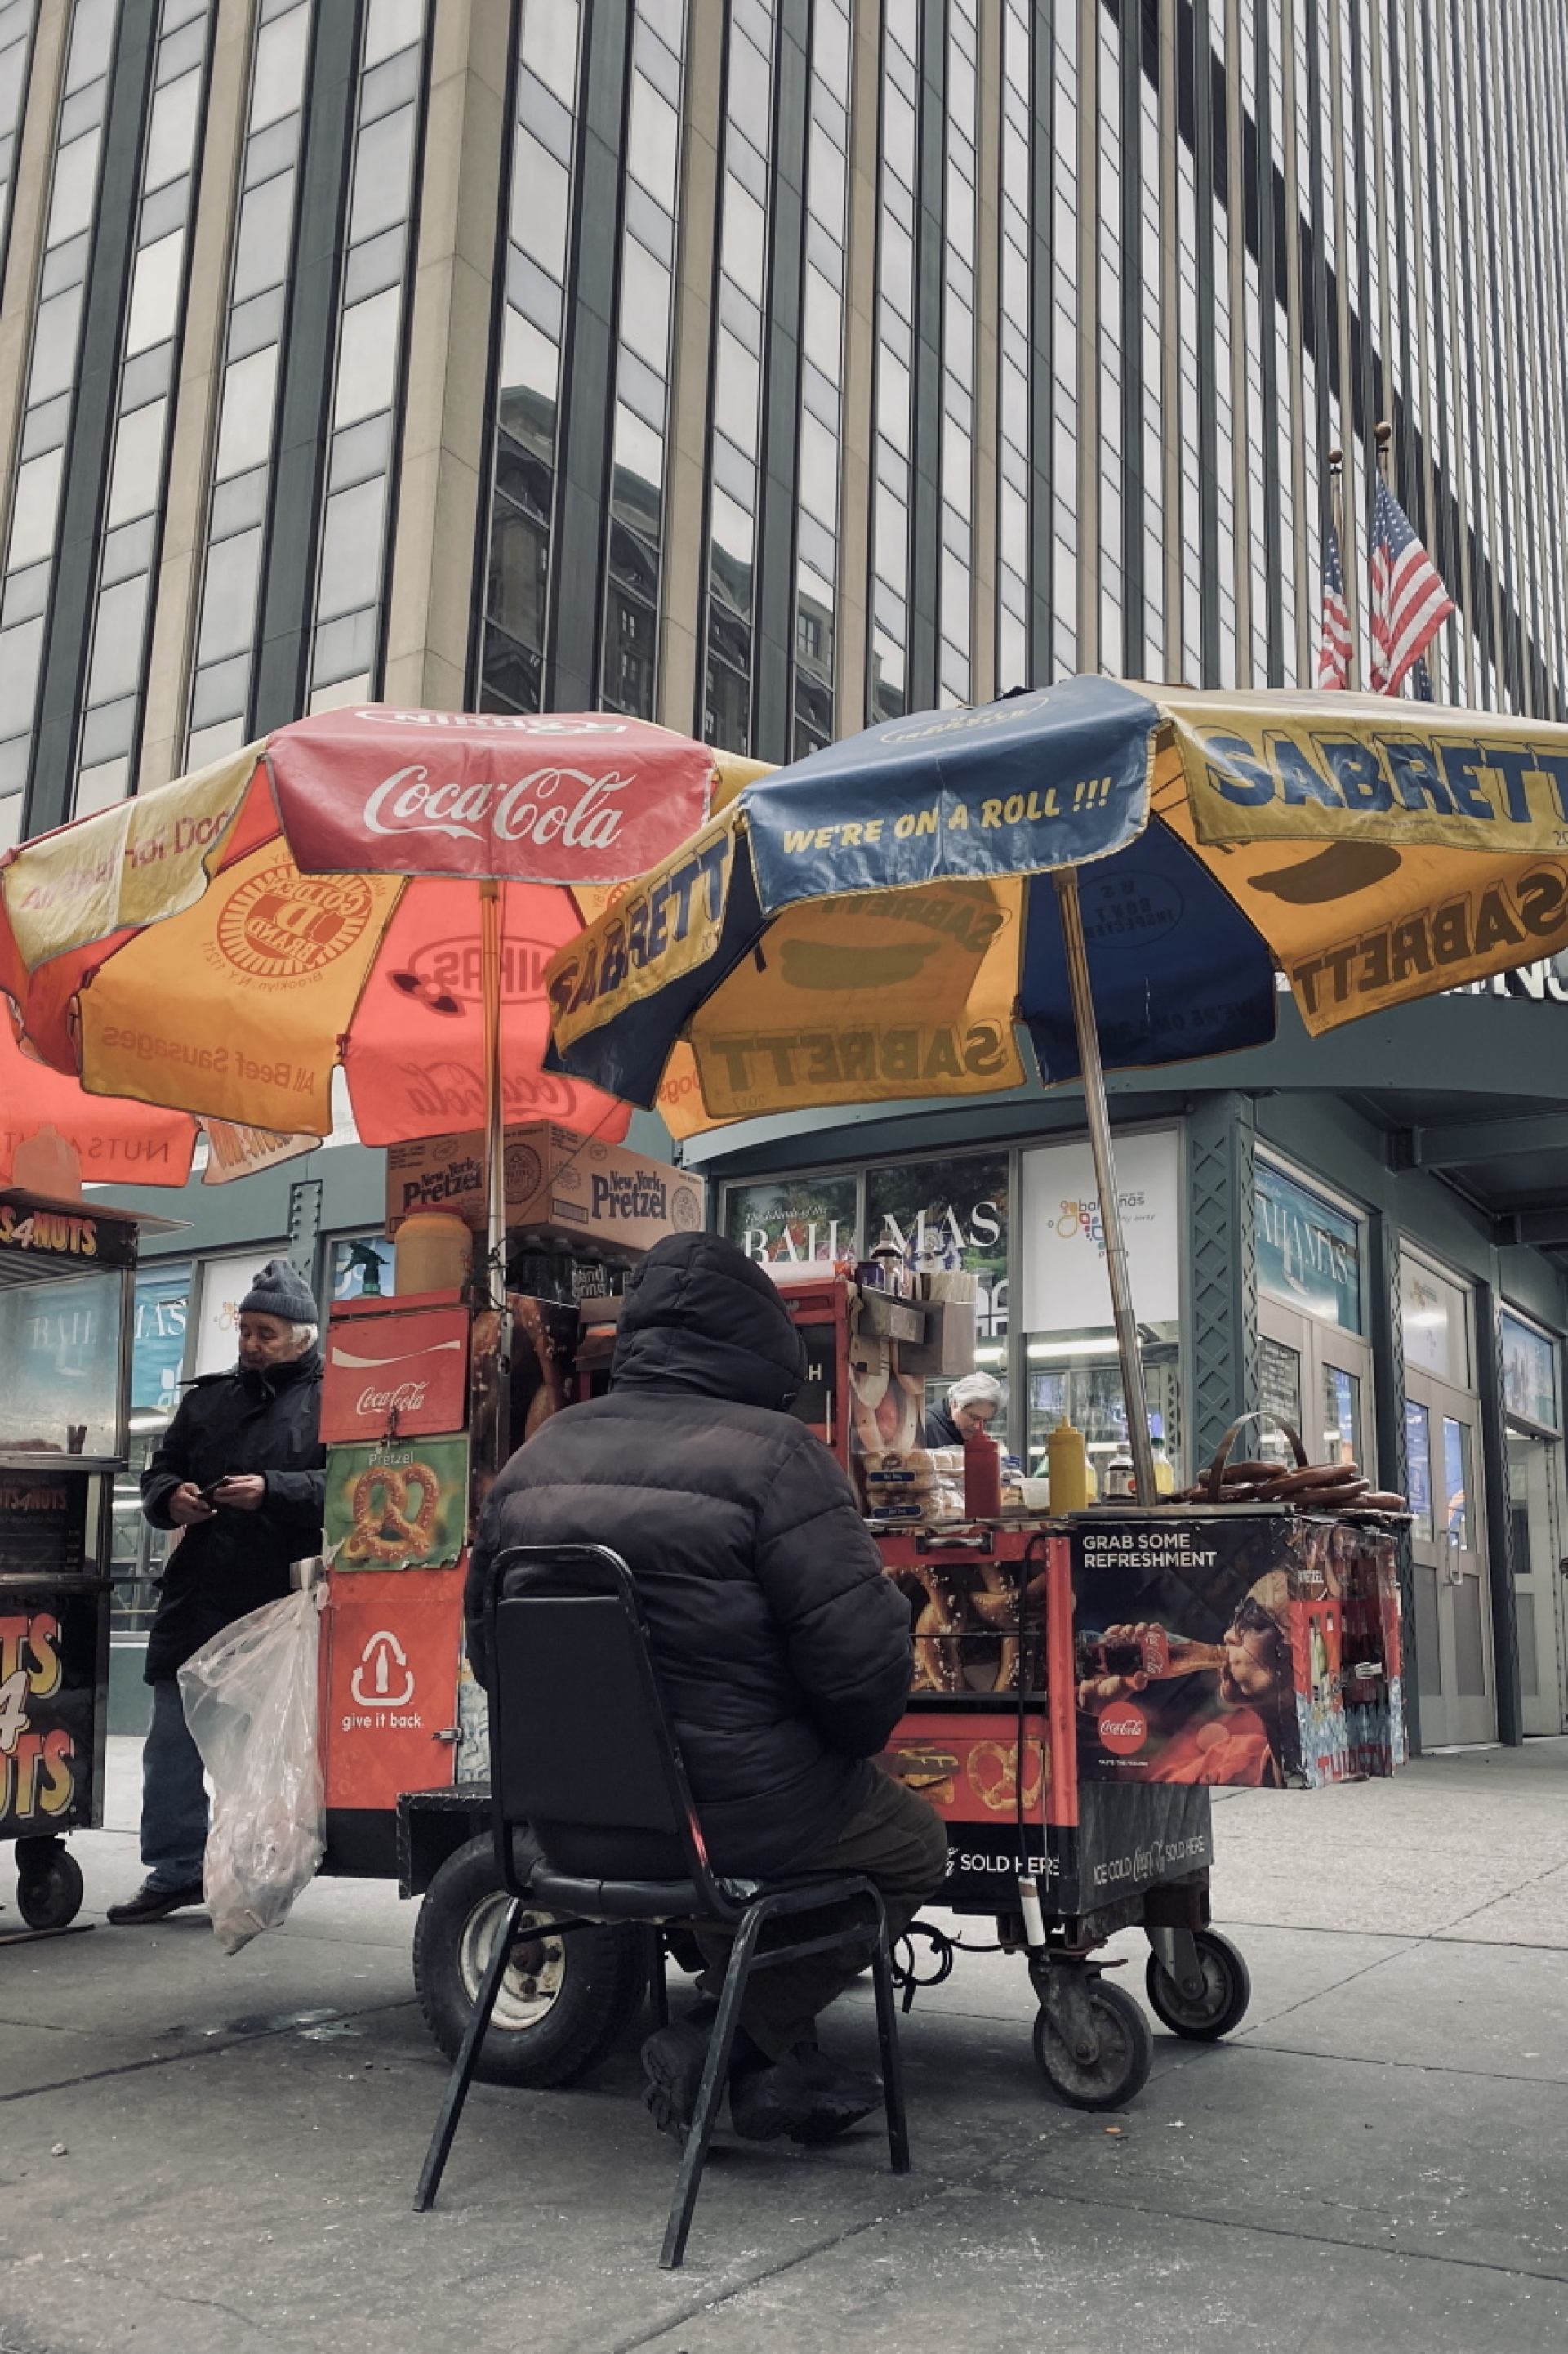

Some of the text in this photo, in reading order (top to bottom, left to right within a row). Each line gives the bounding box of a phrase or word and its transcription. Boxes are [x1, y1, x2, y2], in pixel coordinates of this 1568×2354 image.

[363, 765, 638, 849] Coca-Cola
[782, 776, 1113, 854] WE'RE ON A ROLL !!!
[403, 1168, 483, 1213] Pretzel
[610, 1170, 634, 1192] New
[635, 1170, 662, 1191] York
[591, 1173, 668, 1220] Pretzel
[356, 1381, 429, 1415] Coca-Cola
[368, 1450, 414, 1465] Pretzel
[1082, 1532, 1191, 1551] GRAB SOME
[1083, 1551, 1218, 1569] REFRESHMENT
[342, 1712, 372, 1732] give
[376, 1712, 386, 1728] it
[1100, 1719, 1143, 1737] Coca-Cola
[960, 1854, 1010, 1873] SOLD
[1015, 1855, 1060, 1877] HERE
[1092, 1864, 1107, 1886] ICE
[1108, 1857, 1132, 1880] COLD
[1165, 1841, 1185, 1863] SOLD
[1185, 1835, 1205, 1857] HERE
